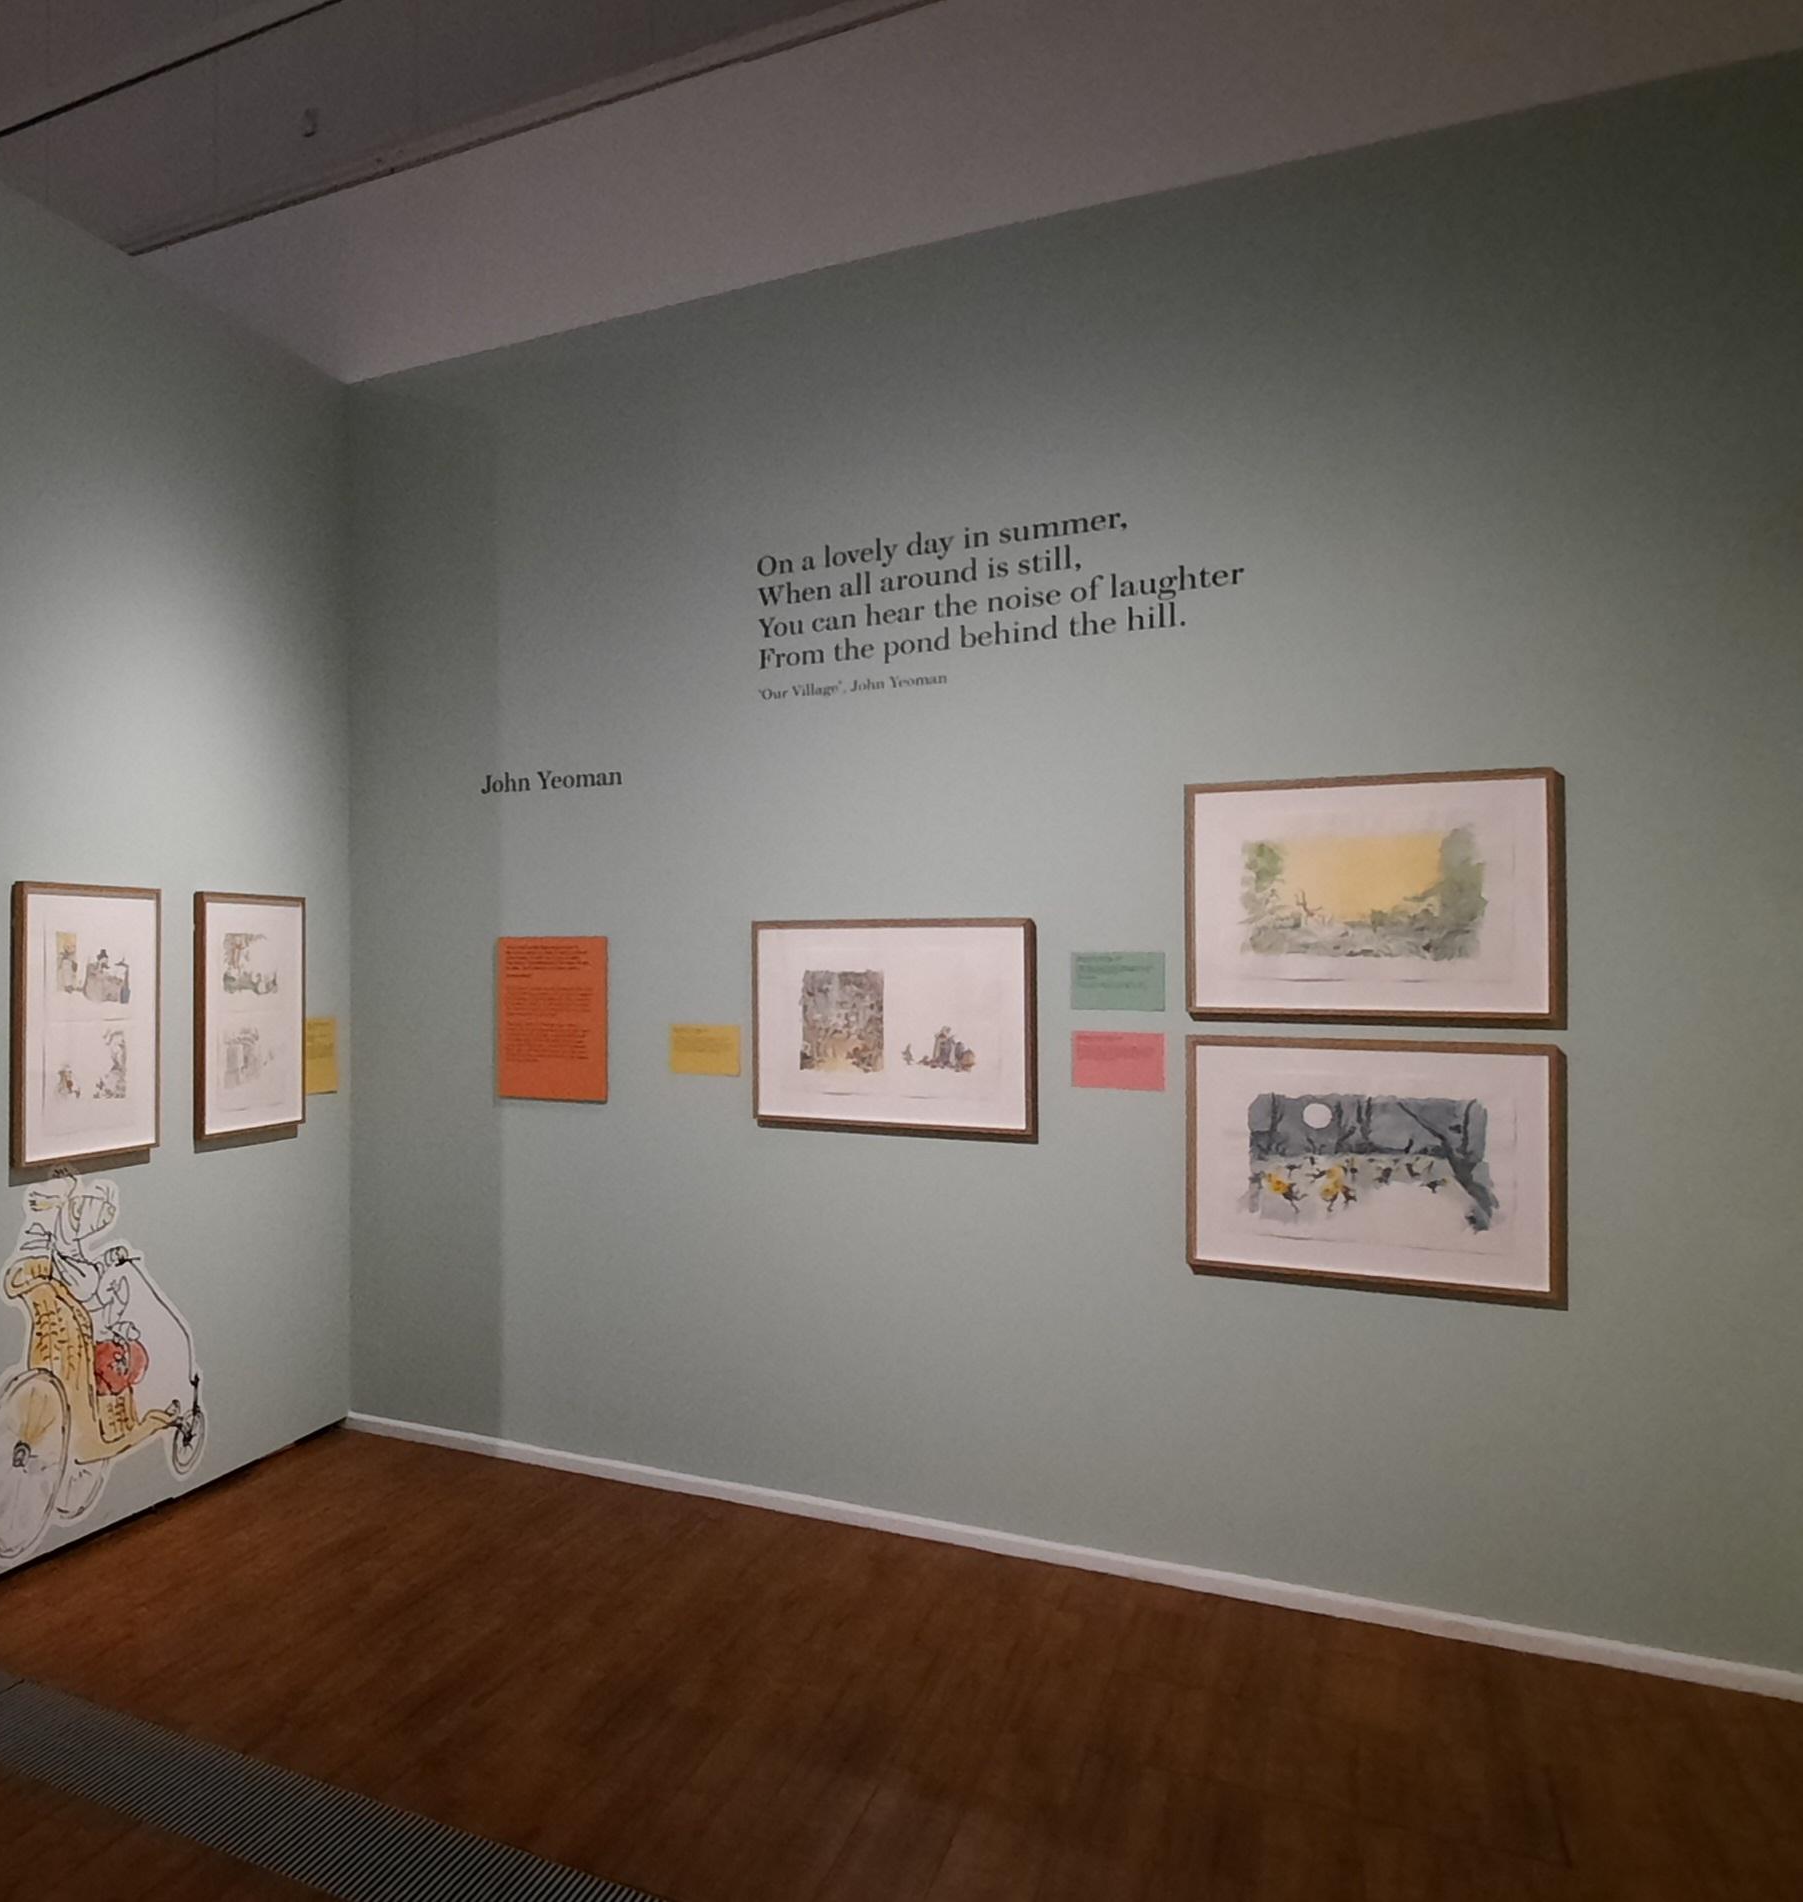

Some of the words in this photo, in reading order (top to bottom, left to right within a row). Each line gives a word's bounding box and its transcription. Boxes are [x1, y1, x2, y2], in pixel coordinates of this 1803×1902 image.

[756, 554, 794, 577] On
[801, 554, 816, 572] a
[824, 537, 899, 568] lovely
[906, 530, 955, 561] day
[963, 527, 989, 550] in
[998, 511, 1128, 545] summer,
[757, 581, 832, 607] When
[839, 570, 871, 598] all
[880, 557, 977, 593] around
[987, 557, 1009, 579] is
[1017, 544, 1082, 576] still,
[758, 616, 804, 639] You
[811, 612, 856, 633] can
[865, 602, 925, 627] hear
[934, 592, 978, 619] the
[987, 586, 1061, 613] noise
[1070, 574, 1104, 603] of
[1110, 564, 1245, 600] laughter
[759, 647, 825, 669] From
[834, 637, 875, 662] the
[884, 626, 950, 664] pond
[960, 615, 1058, 649] behind
[1069, 611, 1117, 638] the
[1127, 602, 1186, 632] hill.
[850, 678, 886, 693] John
[889, 674, 948, 689] Yeoman
[480, 771, 531, 795] John
[536, 770, 623, 790] Yeoman
